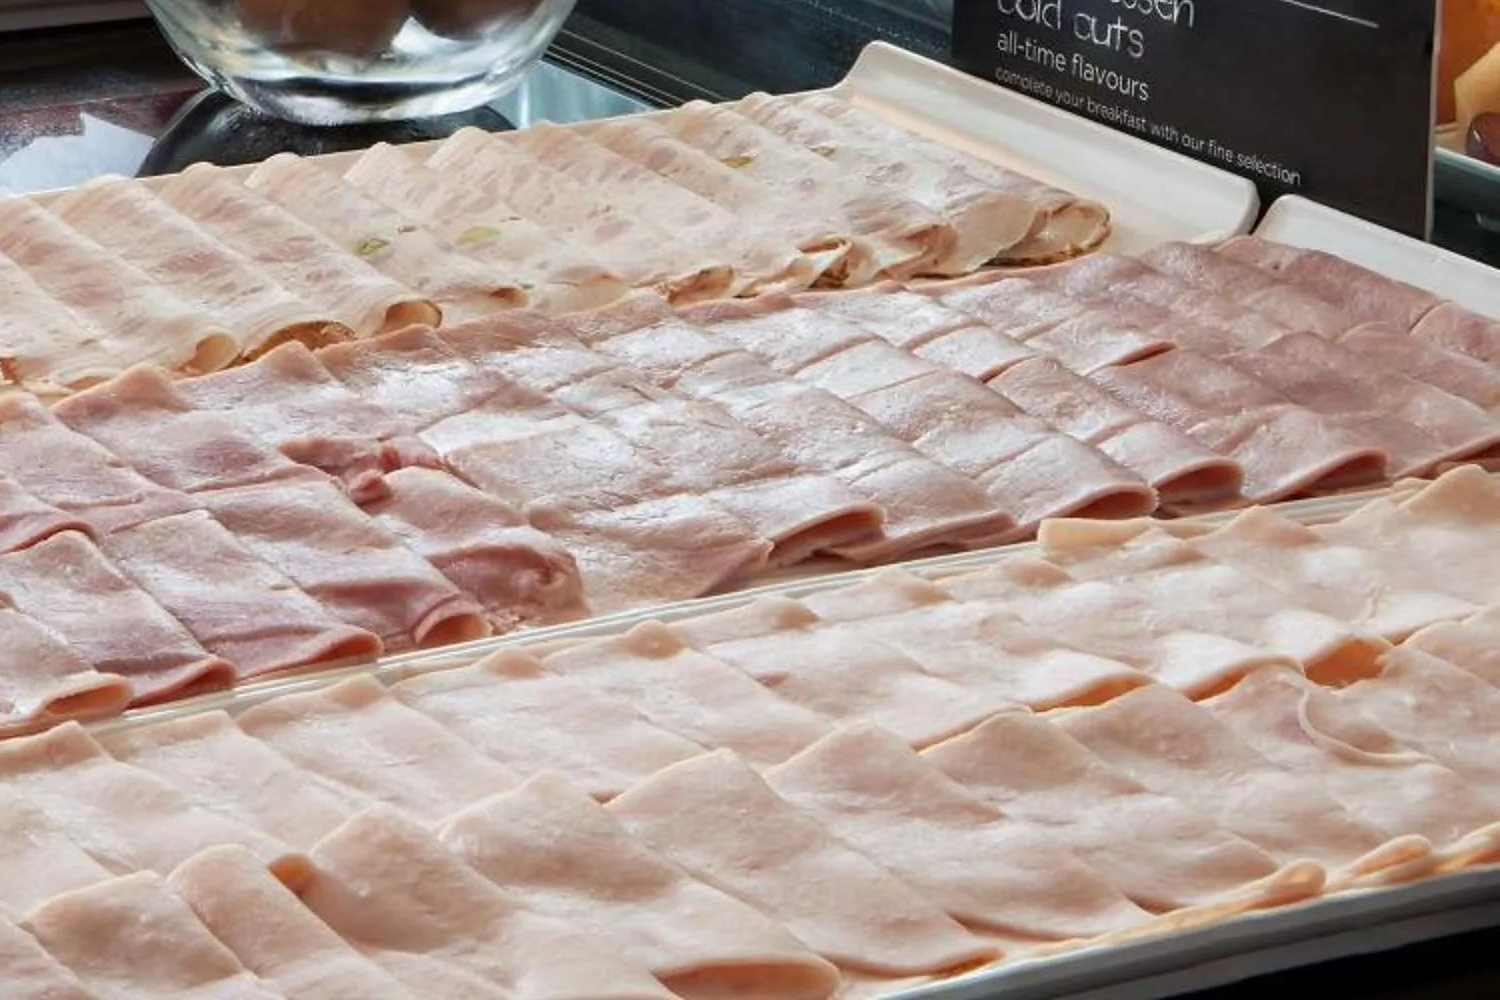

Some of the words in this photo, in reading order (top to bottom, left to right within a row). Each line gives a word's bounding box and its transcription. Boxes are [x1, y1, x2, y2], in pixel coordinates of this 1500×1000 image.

[997, 30, 1067, 72] all-time
[1070, 52, 1150, 102] flavours
[1073, 14, 1144, 59] cuts
[995, 66, 1053, 99] complete
[1055, 89, 1086, 110] your
[1087, 95, 1148, 131] breakfast
[1150, 121, 1179, 143] with
[1181, 133, 1205, 152] our
[1207, 138, 1234, 163] fine
[1236, 152, 1300, 186] selection
